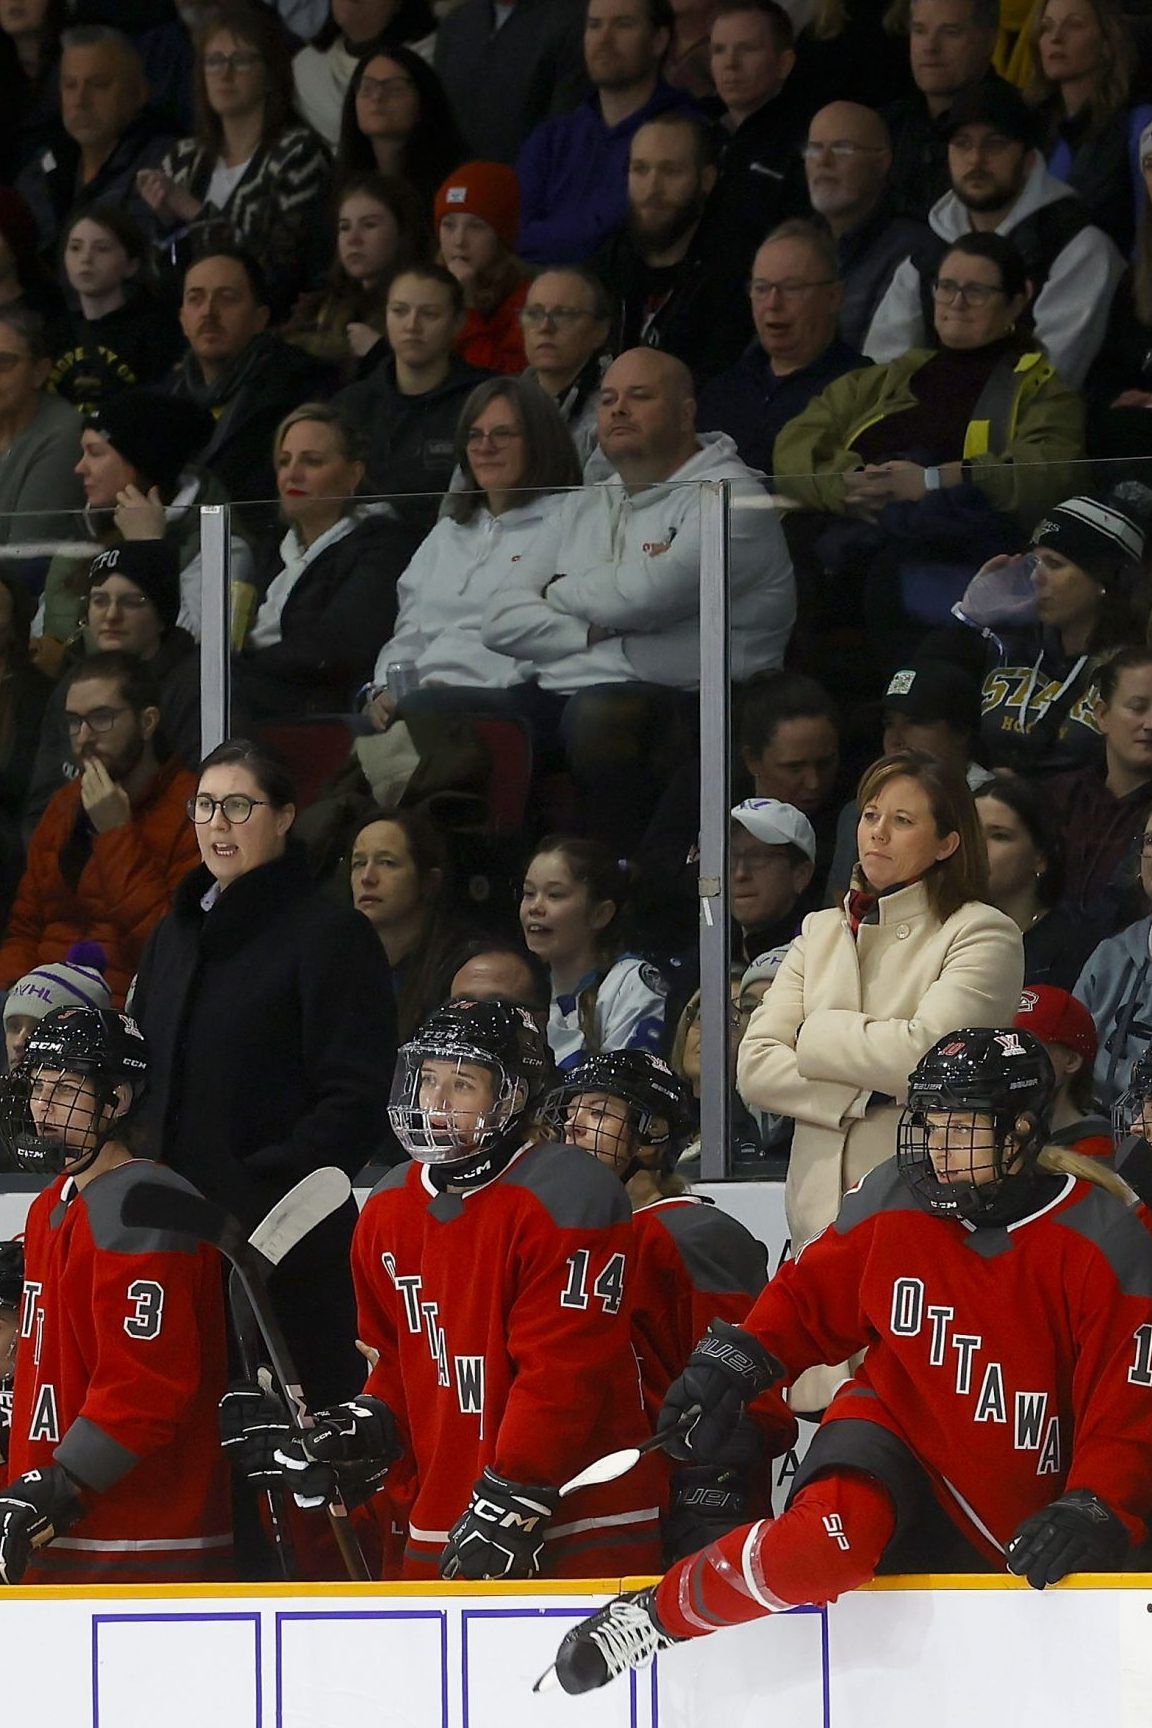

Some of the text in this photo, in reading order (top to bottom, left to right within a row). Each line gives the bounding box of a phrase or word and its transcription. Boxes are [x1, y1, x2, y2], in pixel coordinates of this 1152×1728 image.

[12, 984, 54, 1005] WHL
[123, 1279, 165, 1341] 3
[560, 1248, 627, 1315] 14
[381, 1251, 485, 1441] OTTAW
[889, 1276, 1063, 1477] OTTAWA
[472, 1490, 541, 1533] CM
